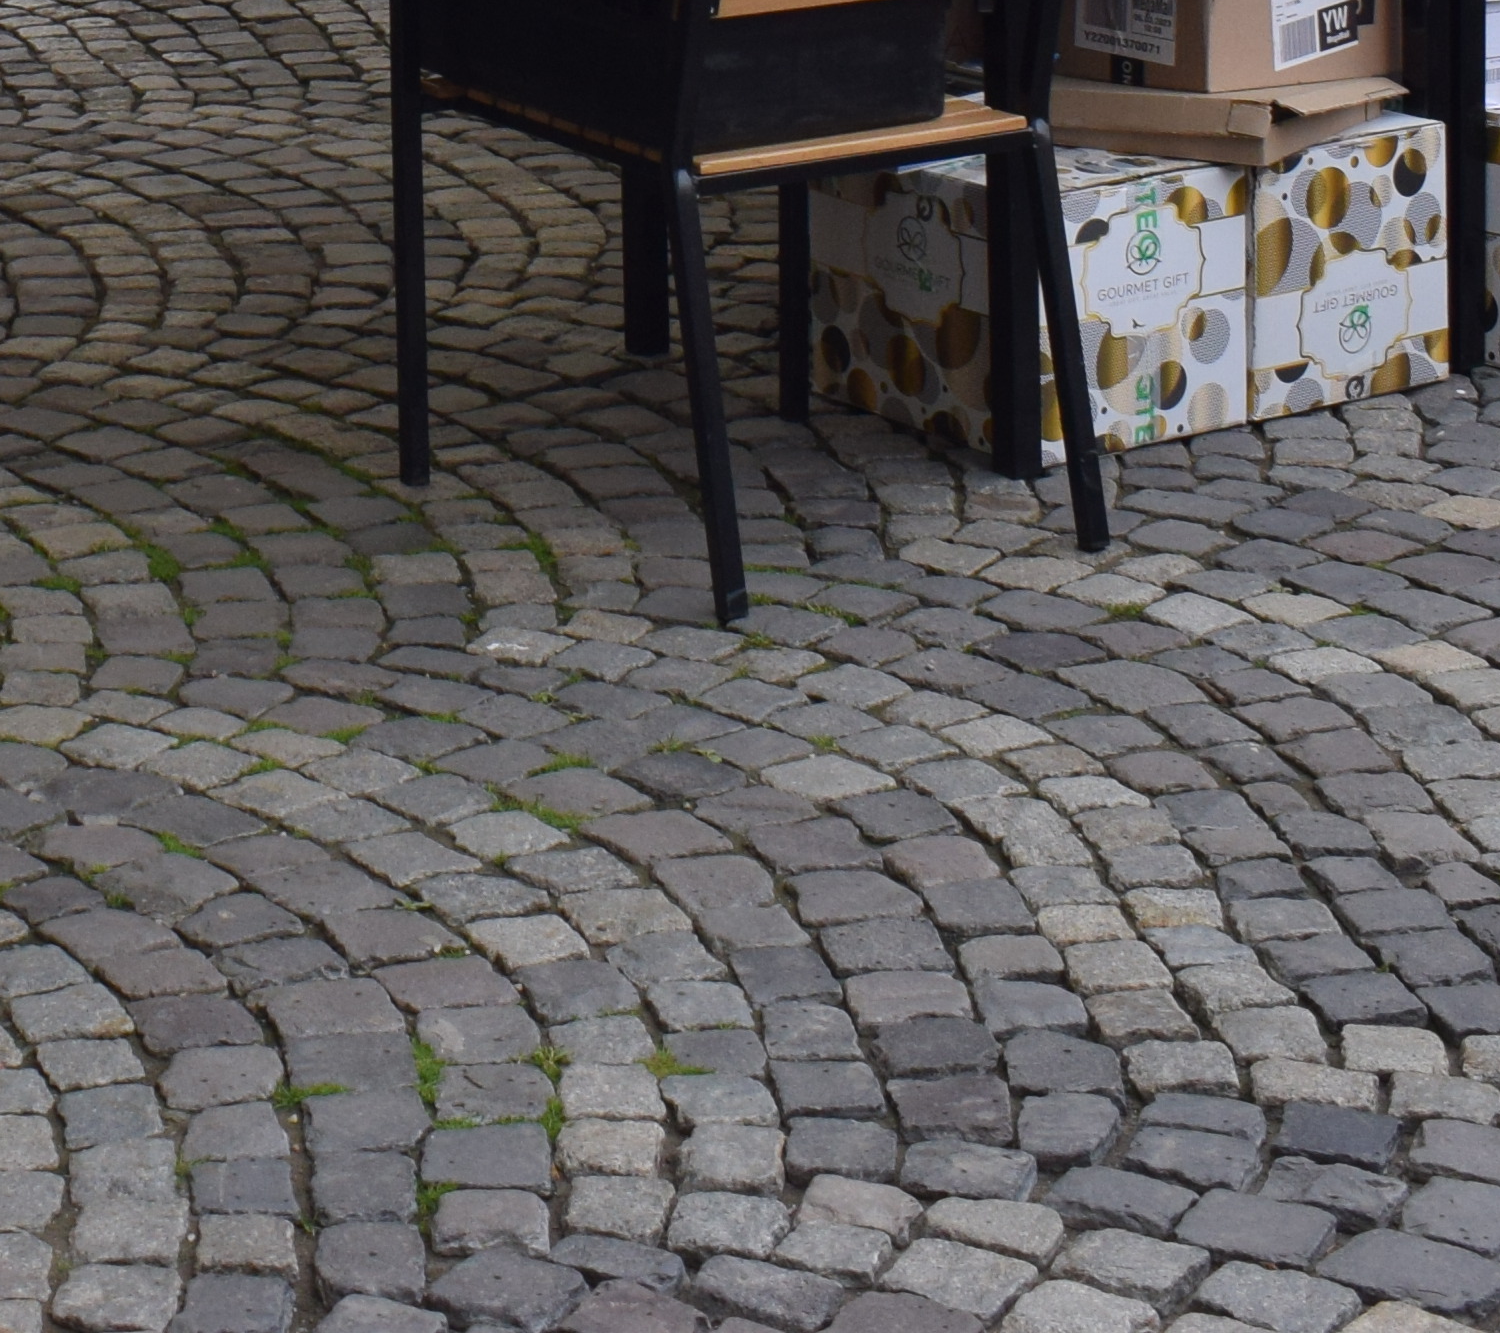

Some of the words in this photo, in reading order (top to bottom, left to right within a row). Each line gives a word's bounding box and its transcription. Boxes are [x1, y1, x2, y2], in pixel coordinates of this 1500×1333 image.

[1322, 4, 1349, 34] YW
[1097, 278, 1159, 302] GOURMET
[1162, 271, 1190, 290] GIFT
[1341, 283, 1399, 310] GOURMET
[1312, 294, 1339, 314] GIFT
